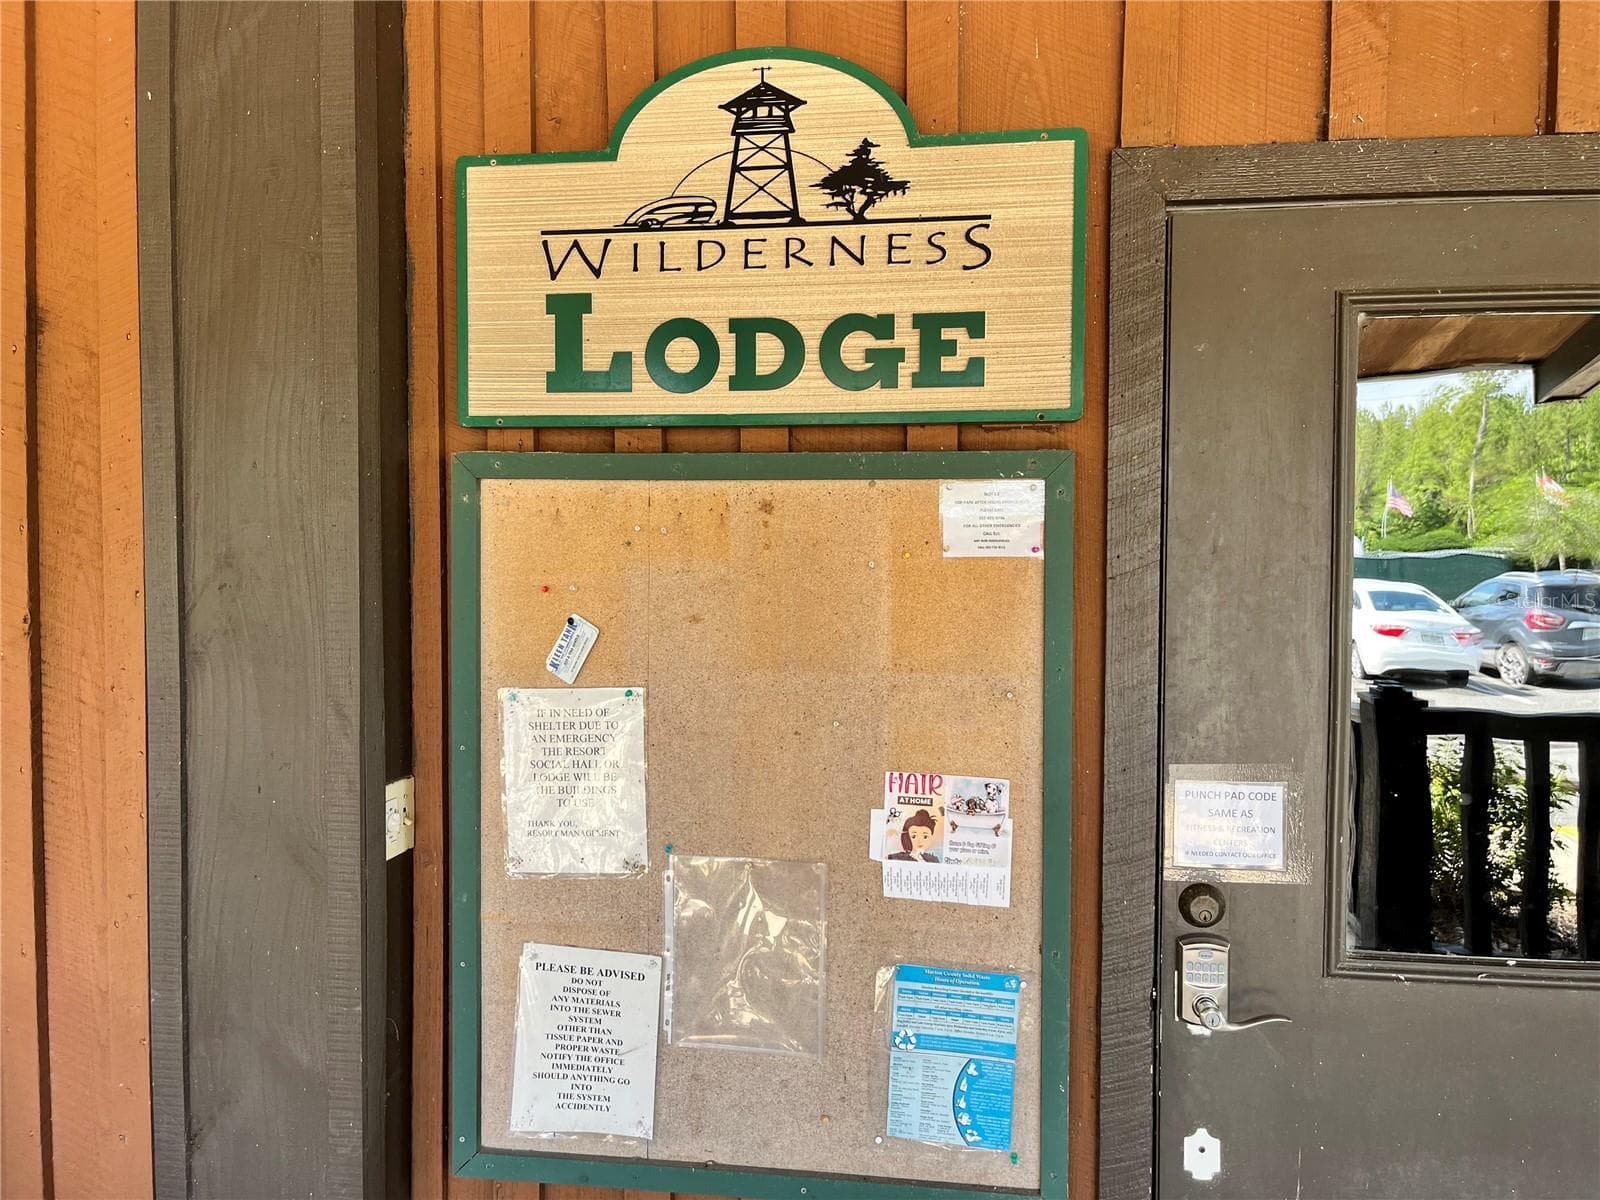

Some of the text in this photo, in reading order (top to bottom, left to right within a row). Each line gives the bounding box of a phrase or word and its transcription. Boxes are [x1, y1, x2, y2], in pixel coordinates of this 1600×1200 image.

[542, 223, 992, 282] WILDERNESS
[545, 292, 986, 394] LODGE
[537, 708, 610, 718] IF IN NEED OF
[528, 720, 618, 730] SHELTER DUE TO
[532, 734, 615, 743] AN EMERGENCY
[542, 747, 606, 756] THE RESORT
[530, 760, 620, 768] SOCIAL HALL OR
[533, 773, 617, 781] LODGE WILL BE
[888, 772, 944, 796] HAIR
[536, 786, 555, 794] THE
[1185, 790, 1277, 801] PUNCH PAD CODE
[556, 799, 594, 807] TO USE
[1208, 809, 1254, 818] SAME AS
[535, 962, 645, 981] PLEASE BE ADVISED
[925, 968, 942, 976] Marion
[943, 970, 961, 978] County
[586, 978, 603, 986] NOT
[563, 986, 597, 996] DISPOSE
[572, 997, 621, 1007] MATERIALS
[550, 1004, 621, 1017] INTO THE SEWER
[568, 1015, 602, 1024] SYSTEM
[557, 1024, 612, 1035] OTHER THAN
[577, 1035, 603, 1044] PAPER
[606, 1038, 623, 1046] AND
[555, 1043, 620, 1055] PROPER WASTE
[541, 1052, 573, 1060] NOTIFY
[594, 1056, 624, 1065] OFFICE
[552, 1063, 613, 1074] IMMEDIATELY
[532, 1072, 568, 1080] SHOULD
[570, 1073, 616, 1084] ANYTHING
[571, 1083, 592, 1091] INTO
[557, 1092, 611, 1102] THE SYSTEM
[556, 1102, 611, 1112] ACCIDENTLY
